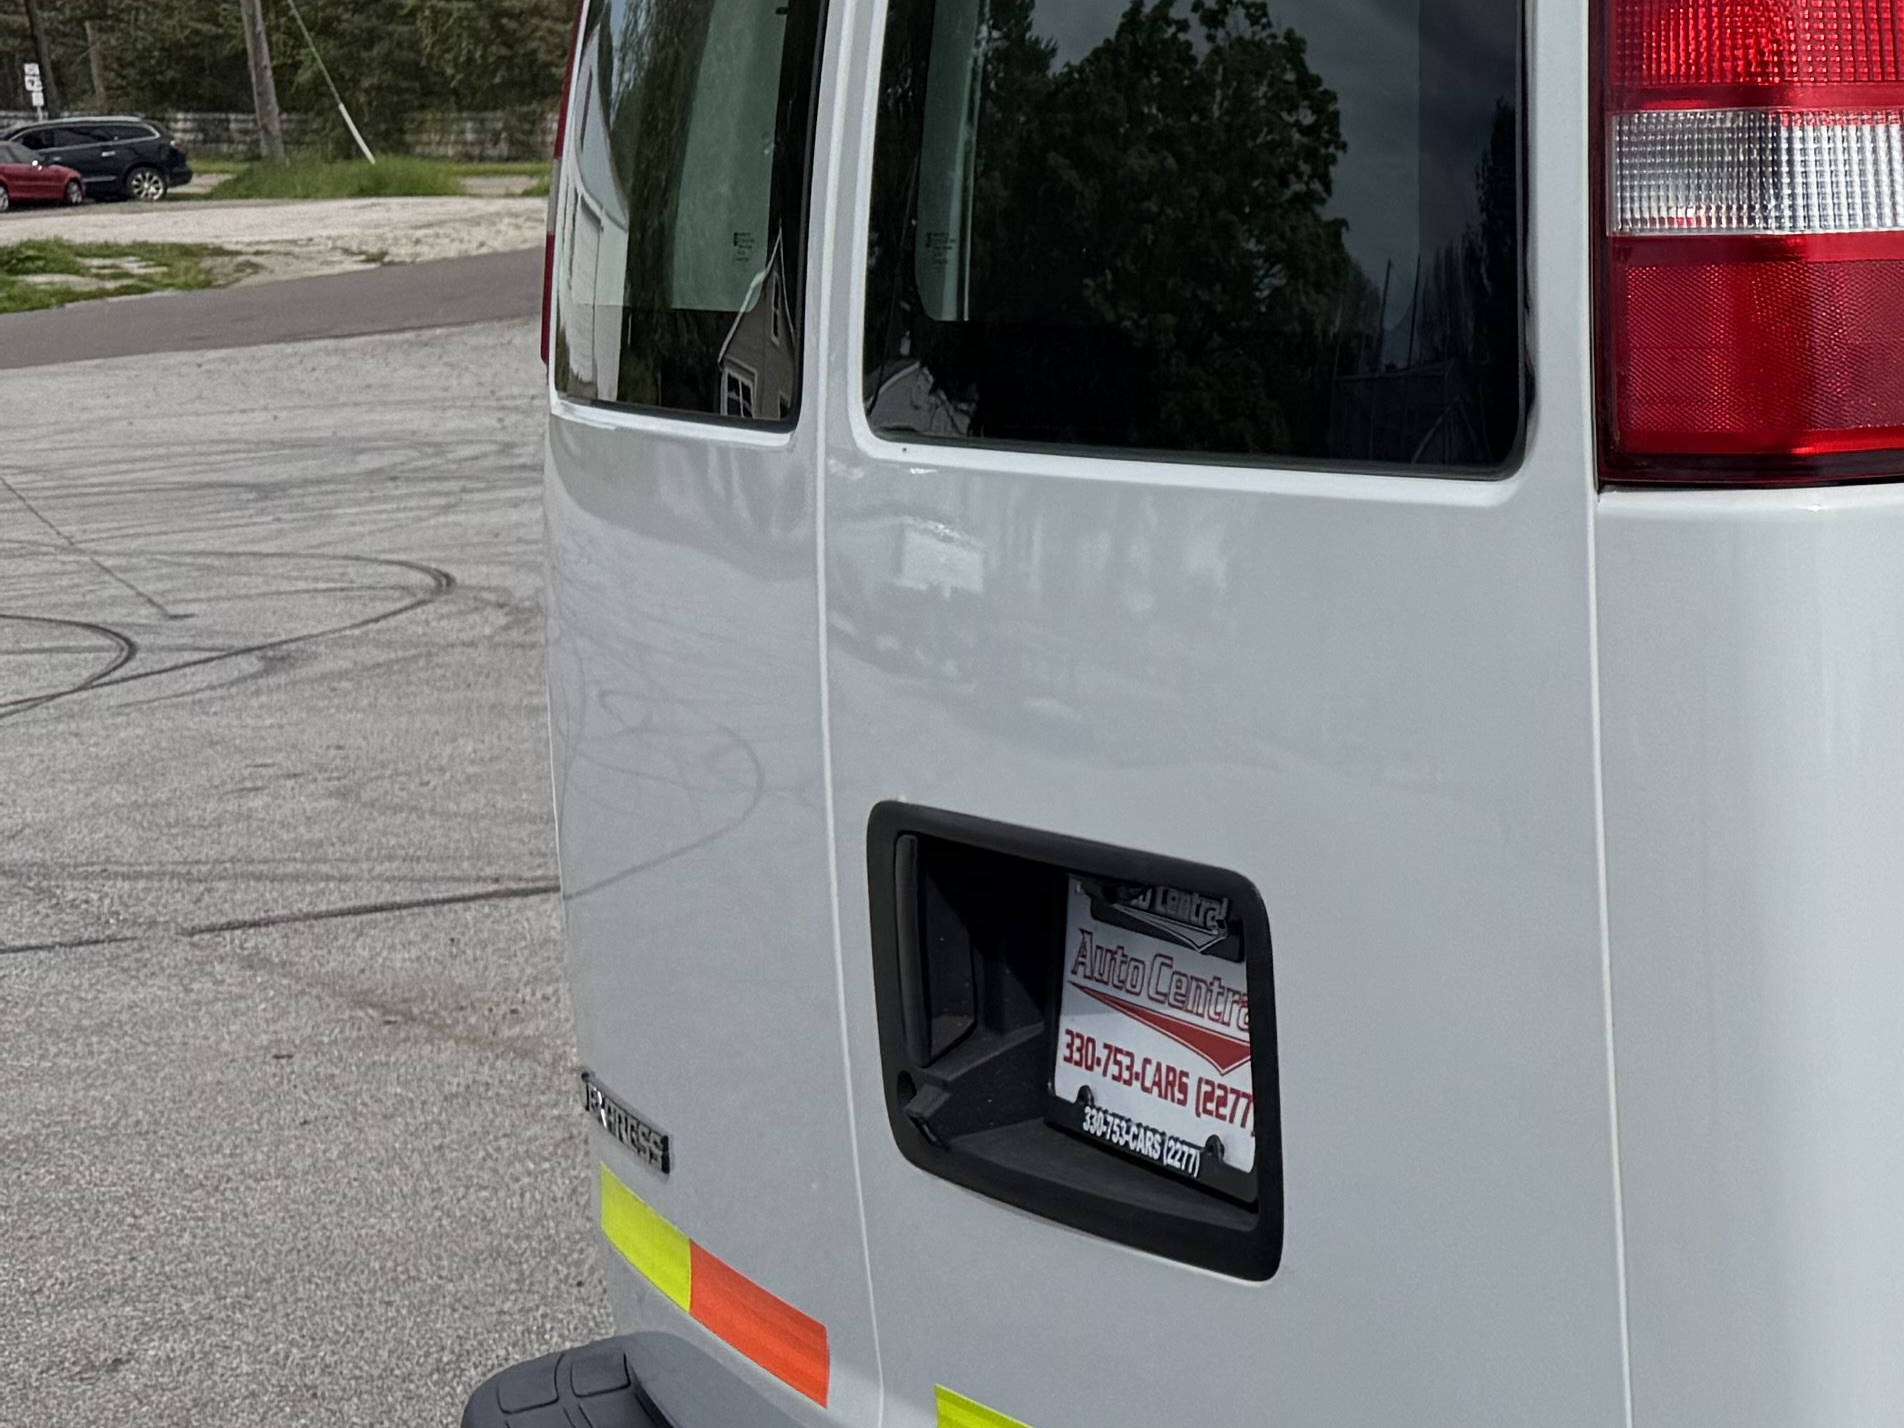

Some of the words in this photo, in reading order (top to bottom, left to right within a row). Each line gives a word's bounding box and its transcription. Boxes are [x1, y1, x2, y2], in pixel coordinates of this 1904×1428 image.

[1071, 928, 1146, 997] Auto
[1148, 953, 1250, 1032] Centra
[1063, 1028, 1190, 1107] 330-753-CARS
[1195, 1076, 1253, 1129] (2277
[1082, 1105, 1162, 1161] 330-753-CARS
[1163, 1134, 1201, 1178] (2277)
